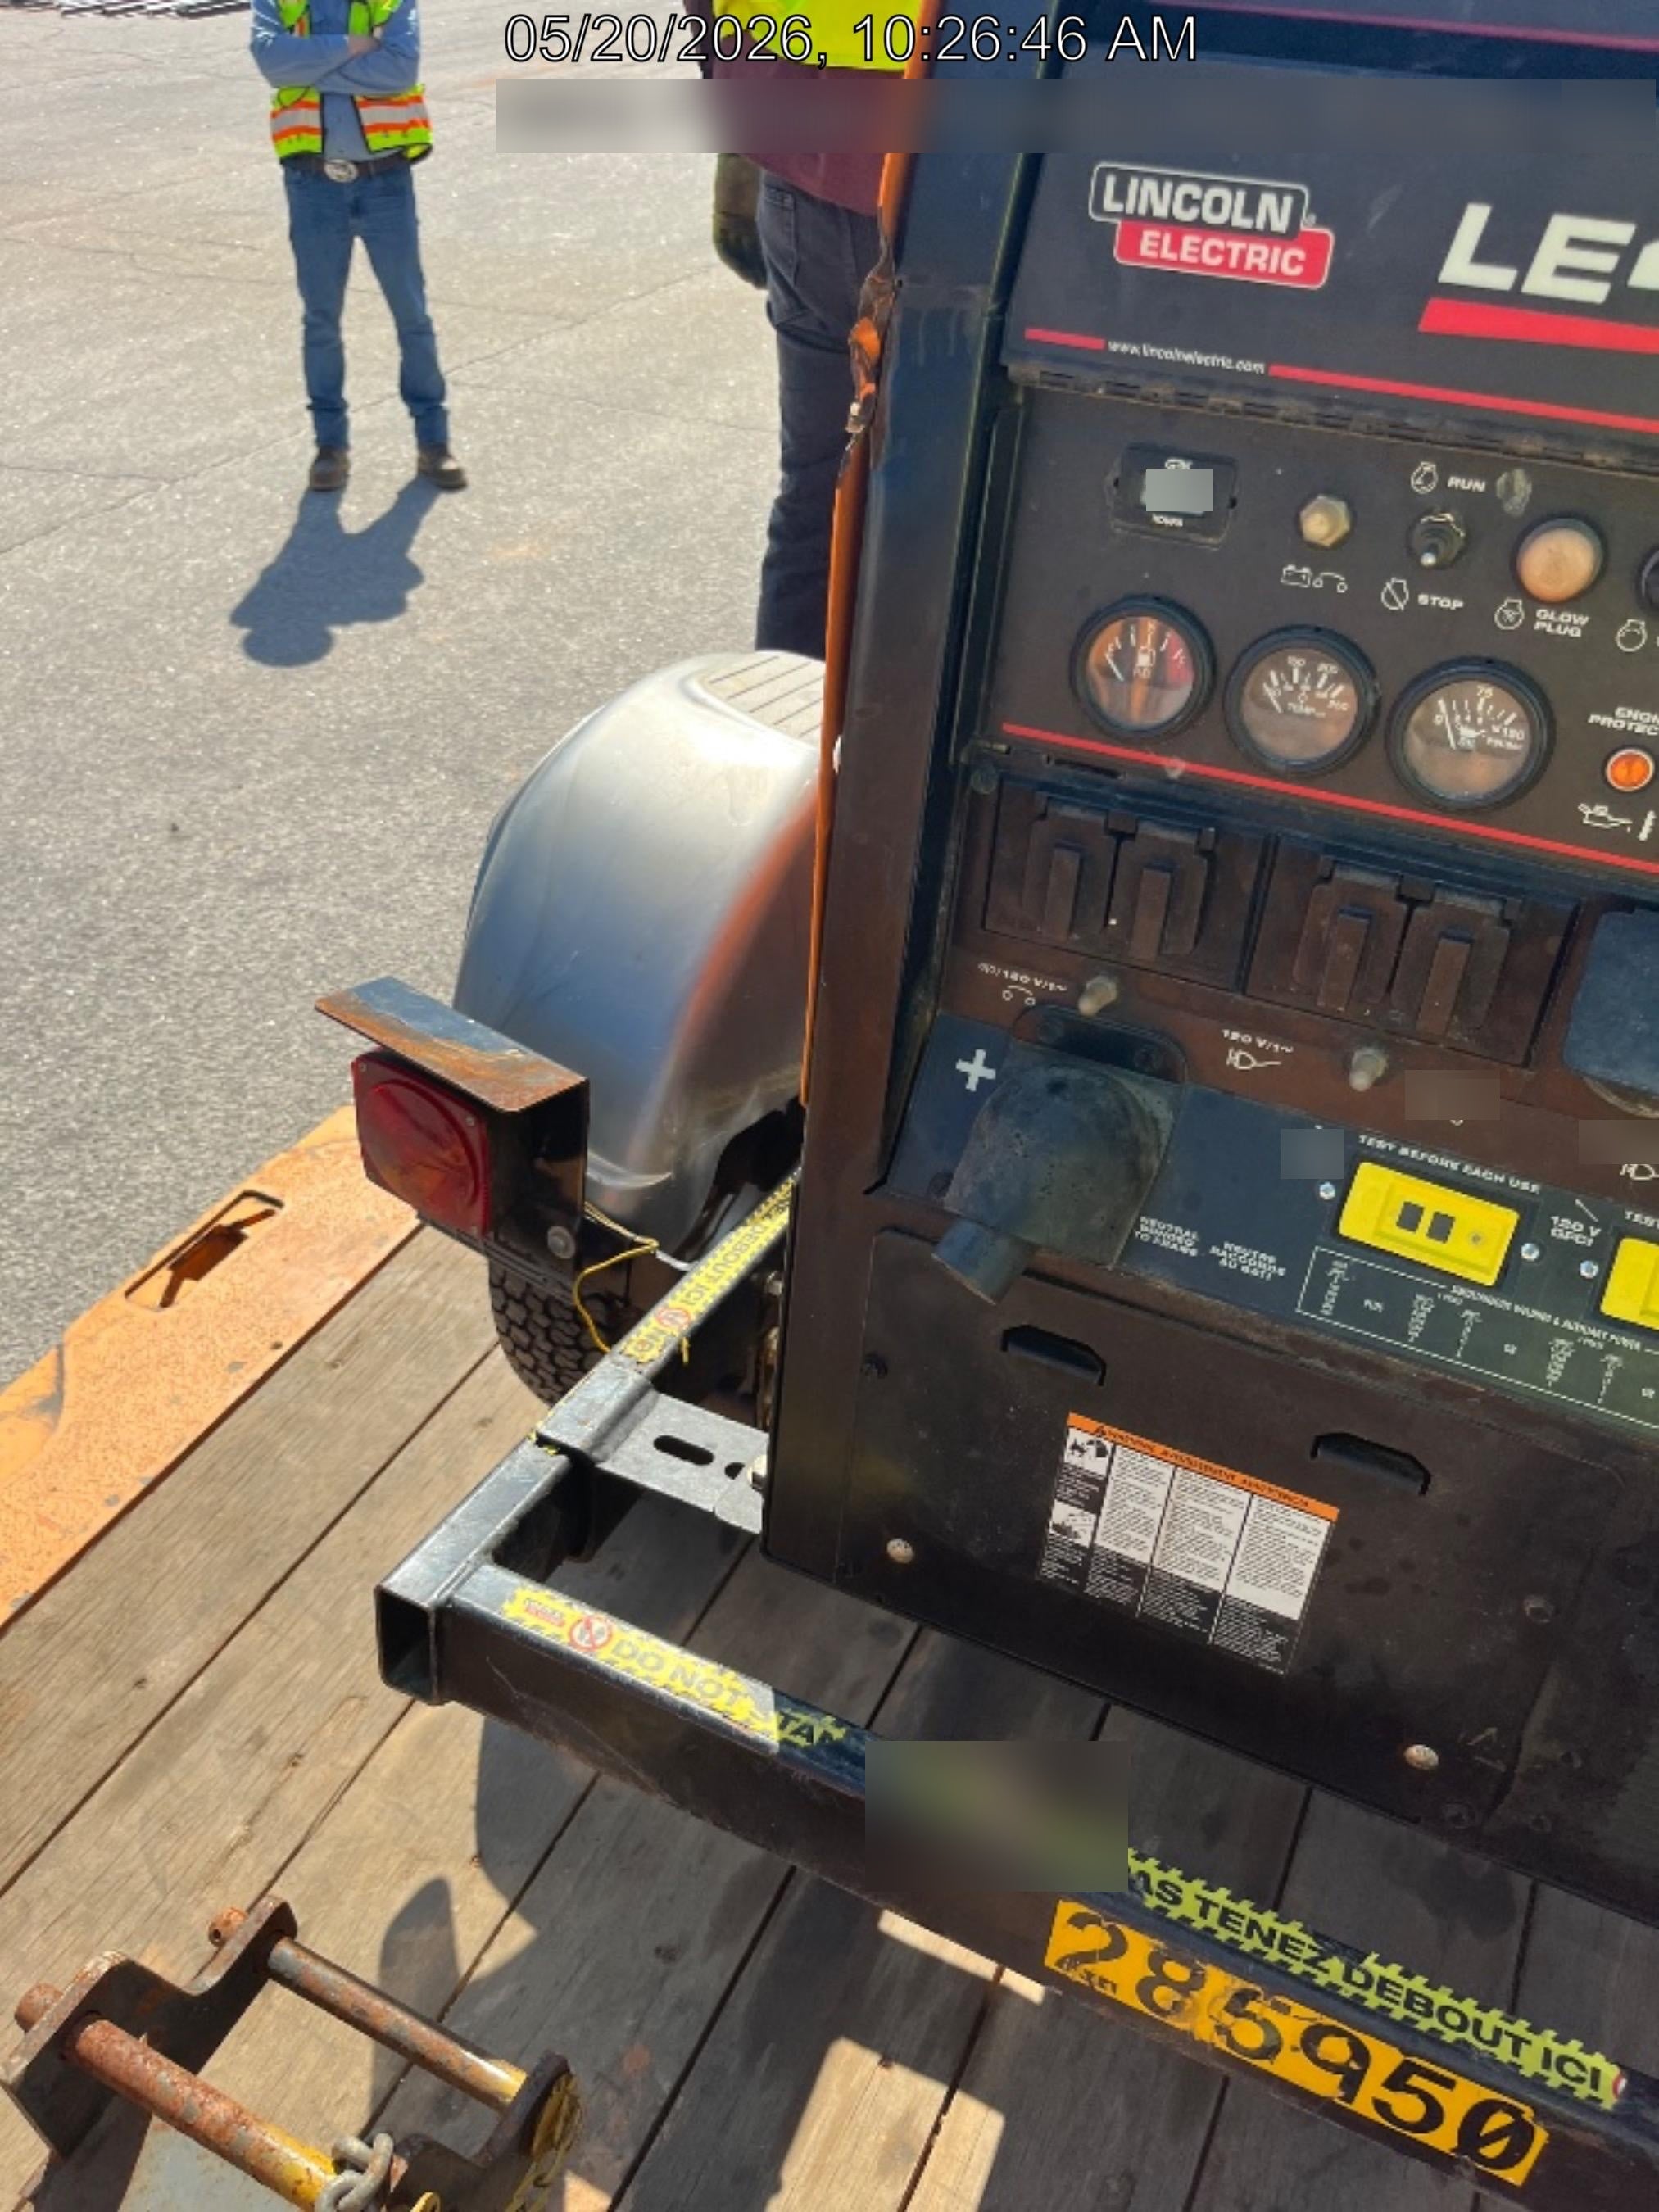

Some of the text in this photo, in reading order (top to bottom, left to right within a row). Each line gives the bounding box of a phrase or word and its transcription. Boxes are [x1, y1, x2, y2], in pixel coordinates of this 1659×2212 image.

[1103, 174, 1294, 234] LINCOLN
[1139, 229, 1308, 277] ELECTRIC
[1447, 476, 1486, 492] RUN
[1417, 594, 1464, 610] STOP
[1535, 609, 1589, 626] GLOW
[1534, 620, 1582, 637] PLUG
[1358, 1134, 1541, 1194] TEST BEFORE EACH USE
[1551, 1216, 1602, 1238] 120 V
[610, 1639, 666, 1676] DO
[669, 1666, 751, 1714] NOT
[1054, 1911, 1535, 2171] 285950
[1343, 1964, 1532, 2059] DEBOUT
[1541, 2046, 1602, 2093] ICI
